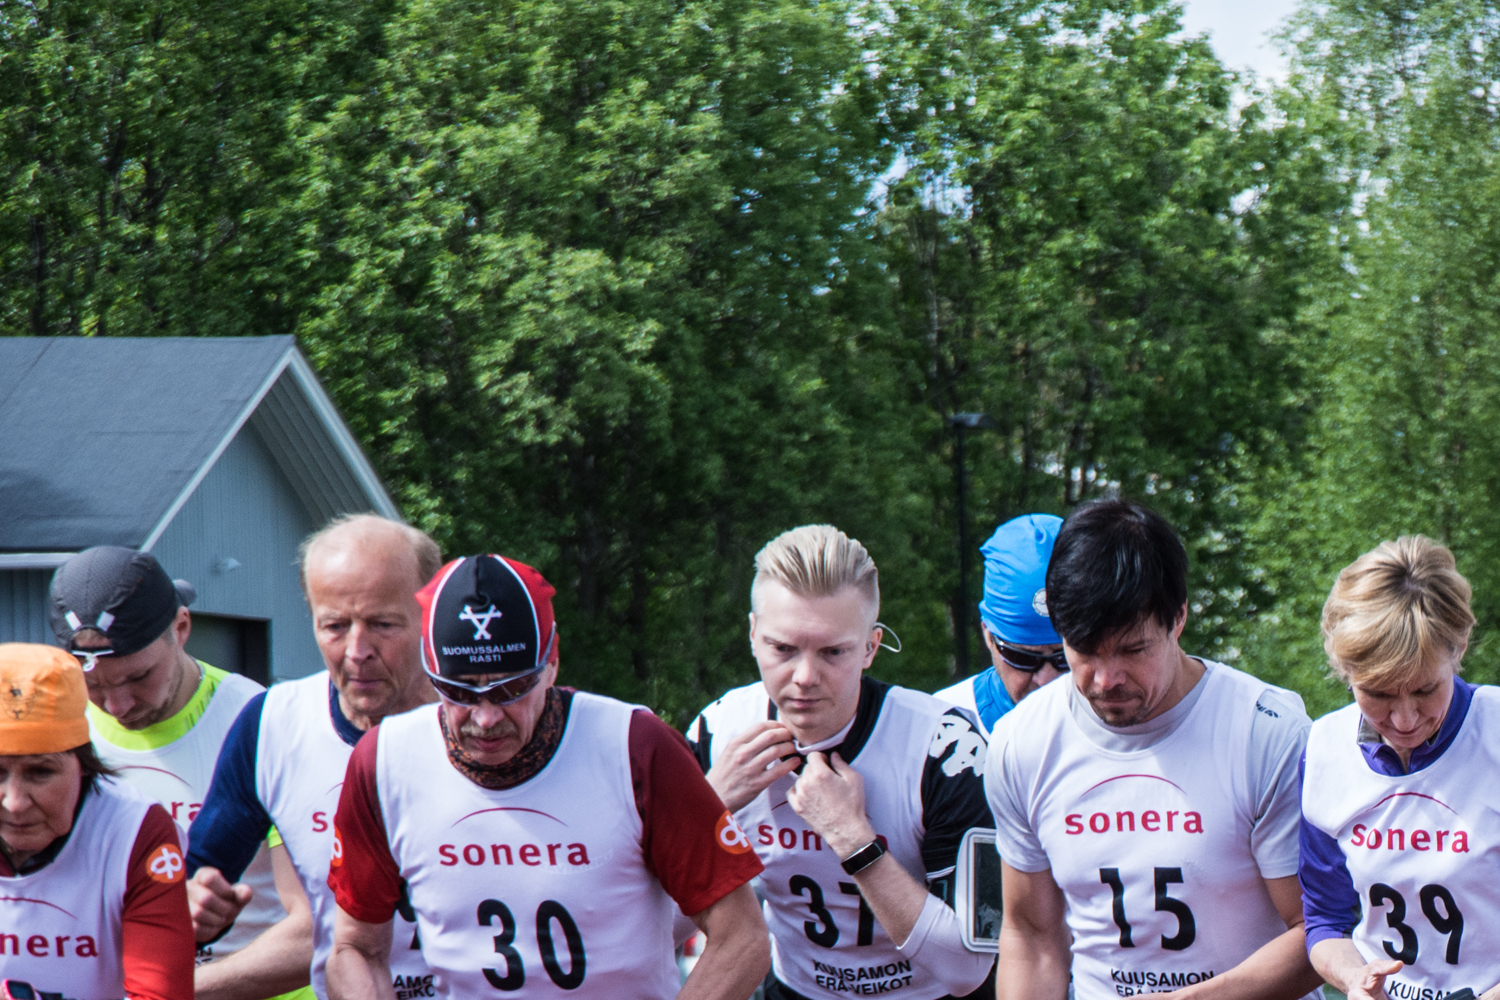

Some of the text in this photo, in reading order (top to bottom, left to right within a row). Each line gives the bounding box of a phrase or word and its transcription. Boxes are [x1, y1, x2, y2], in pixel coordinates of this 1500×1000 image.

[442, 641, 526, 655] SUOMUSSALMEN
[469, 655, 501, 663] RASTI
[1065, 810, 1204, 835] sonera
[1351, 823, 1470, 853] sonera
[438, 842, 590, 867] sonera
[789, 874, 875, 948] 37
[1099, 867, 1196, 951] 15
[1369, 883, 1464, 966] 39
[0, 933, 98, 958] nera
[477, 899, 587, 991] 30
[812, 959, 912, 982] KUUSAMON
[1111, 968, 1215, 987] KUUSAMON
